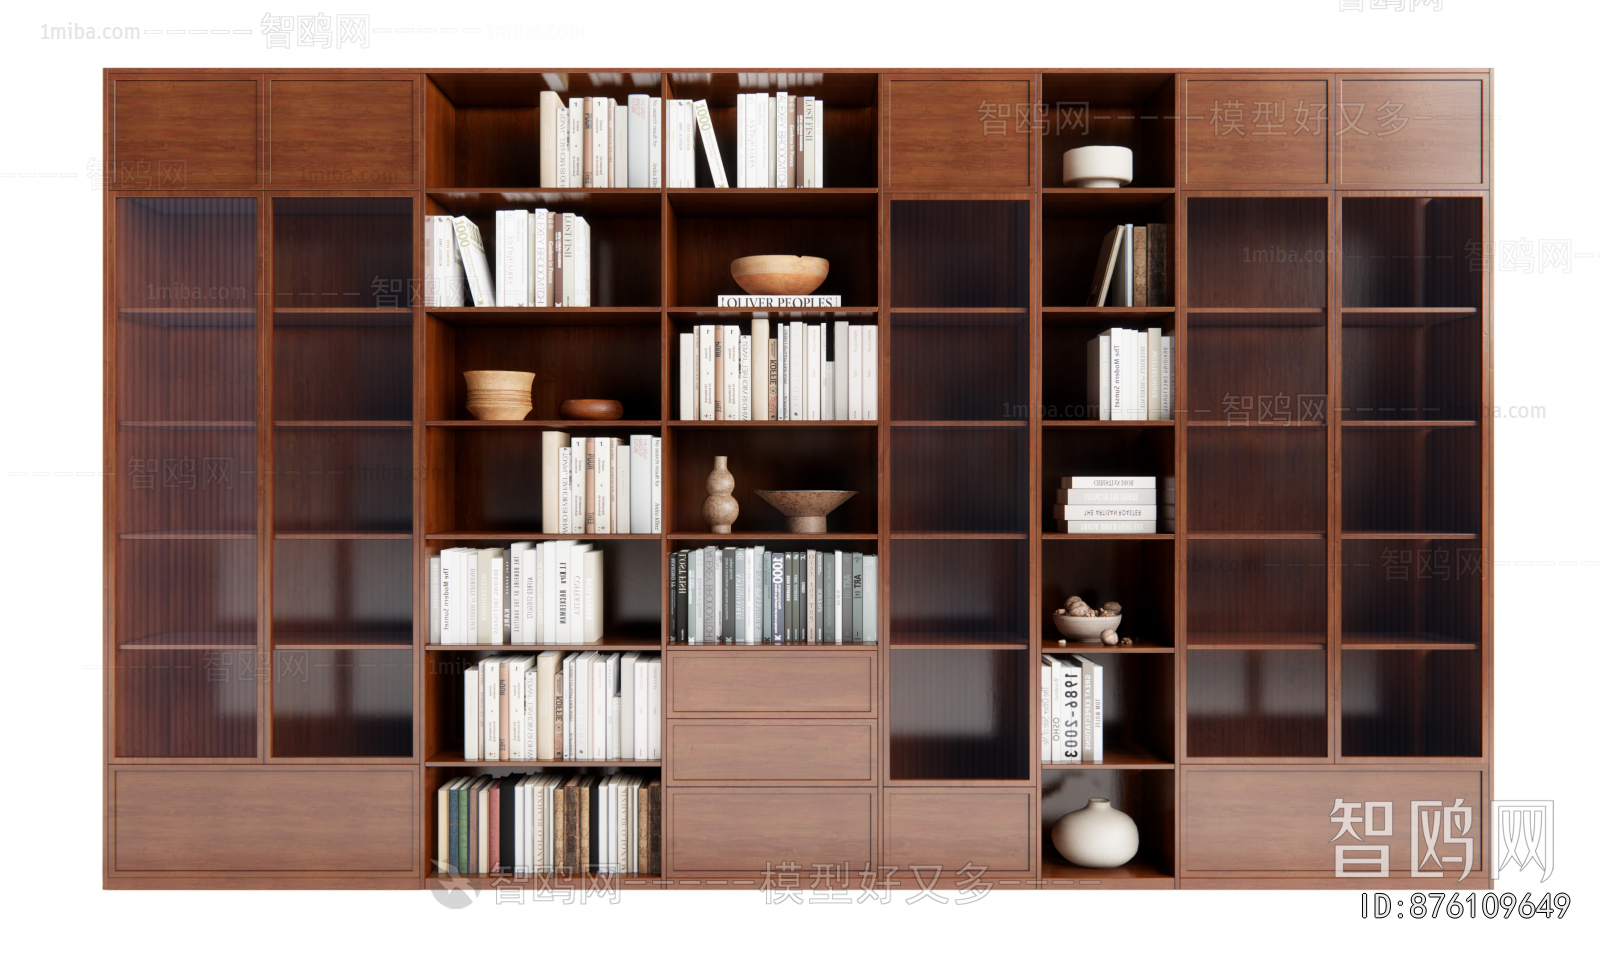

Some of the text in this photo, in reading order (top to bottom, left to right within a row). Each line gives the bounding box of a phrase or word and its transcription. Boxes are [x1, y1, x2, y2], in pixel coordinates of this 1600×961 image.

[695, 104, 711, 131] 1000
[805, 99, 813, 141] LOST FISH
[778, 95, 786, 188] ALEXEY BRODOVITCH
[454, 220, 470, 248] 1000
[536, 211, 545, 304] ALEXEY BRODOVITCH
[726, 297, 833, 307] OLIVER PEOPLES
